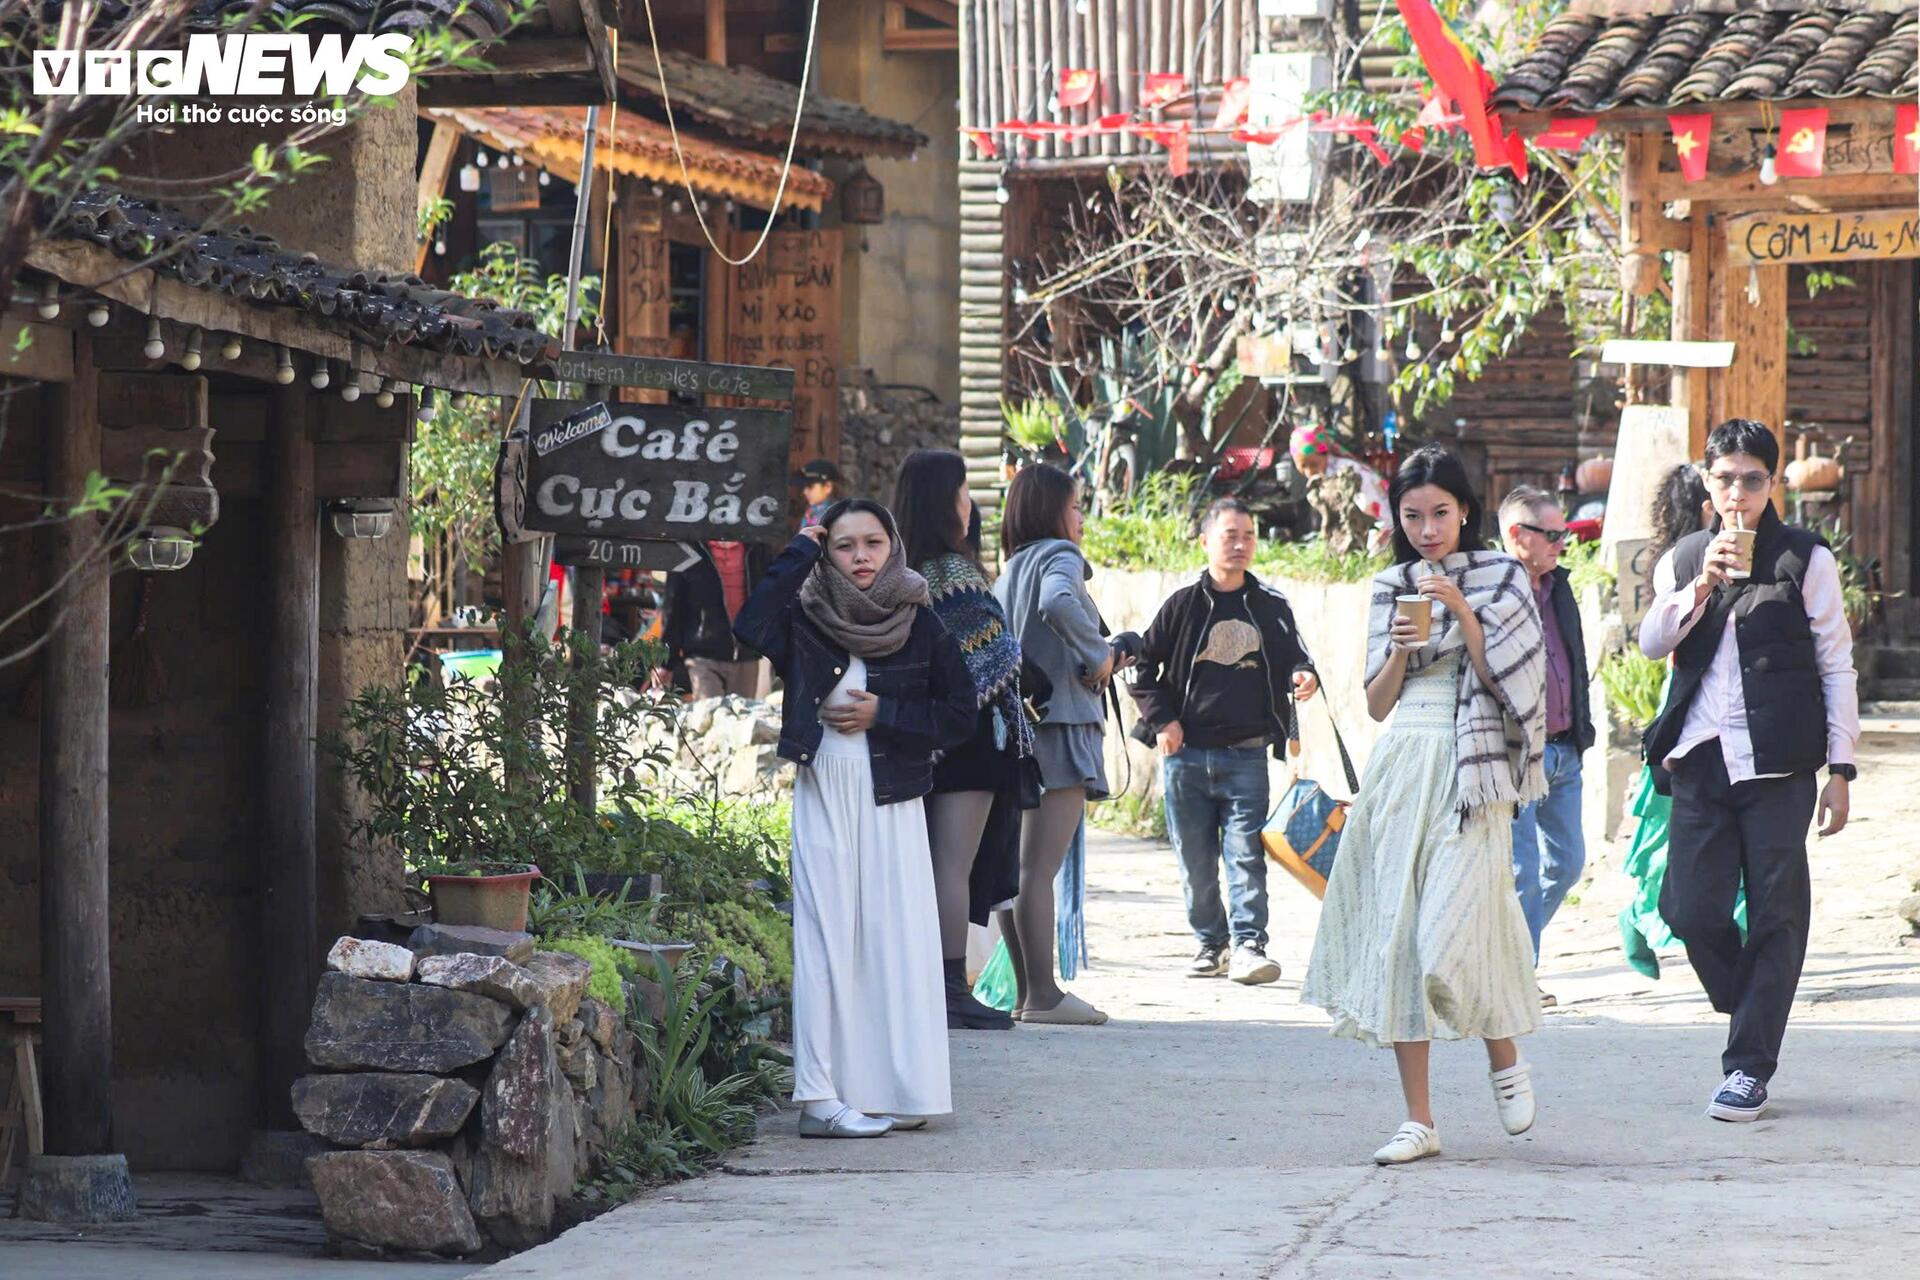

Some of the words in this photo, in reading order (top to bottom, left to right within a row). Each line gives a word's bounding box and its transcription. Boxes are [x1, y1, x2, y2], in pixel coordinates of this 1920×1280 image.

[1745, 222, 1811, 260] CƠM
[537, 410, 608, 450] Welcome
[601, 415, 739, 463] Café
[536, 474, 651, 529] Cực
[664, 472, 778, 526] Bắc
[588, 540, 614, 562] 20
[620, 543, 641, 565] m
